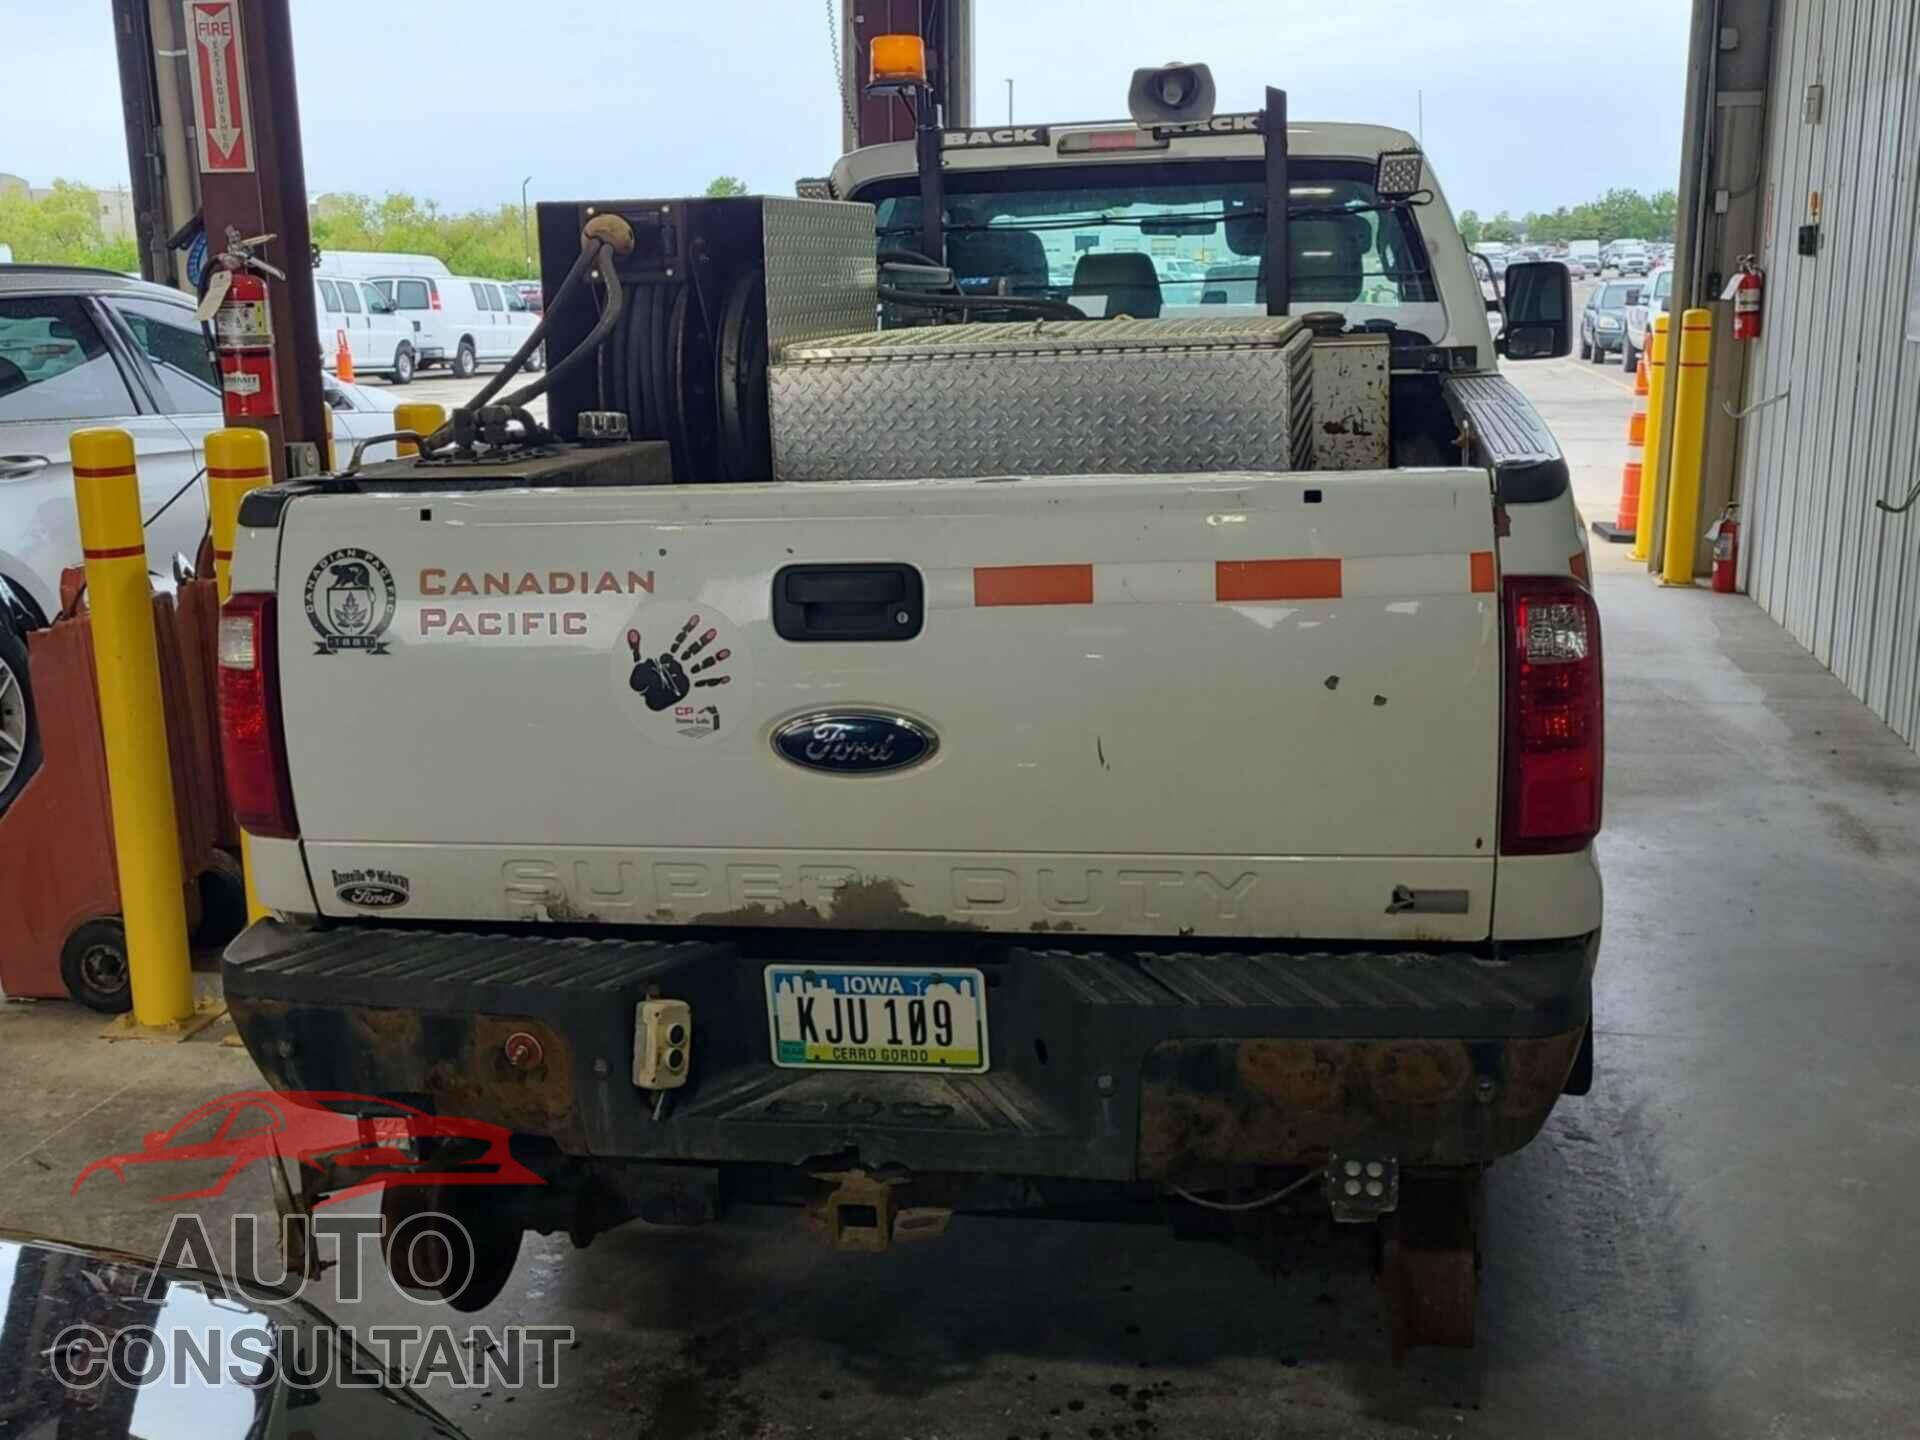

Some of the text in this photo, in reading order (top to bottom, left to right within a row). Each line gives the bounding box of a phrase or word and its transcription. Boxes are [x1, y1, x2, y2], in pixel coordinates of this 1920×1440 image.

[198, 21, 231, 37] FIRE
[943, 128, 1037, 146] BACK
[305, 548, 396, 614] CANADIAN PACIFIC
[675, 706, 694, 716] CP
[805, 722, 896, 761] Ford
[350, 887, 395, 905] Ford
[950, 867, 1259, 919] DUTY
[842, 976, 904, 995] IOWA
[796, 996, 953, 1047] KJU 109
[832, 1046, 929, 1063] CERRO GORDO
